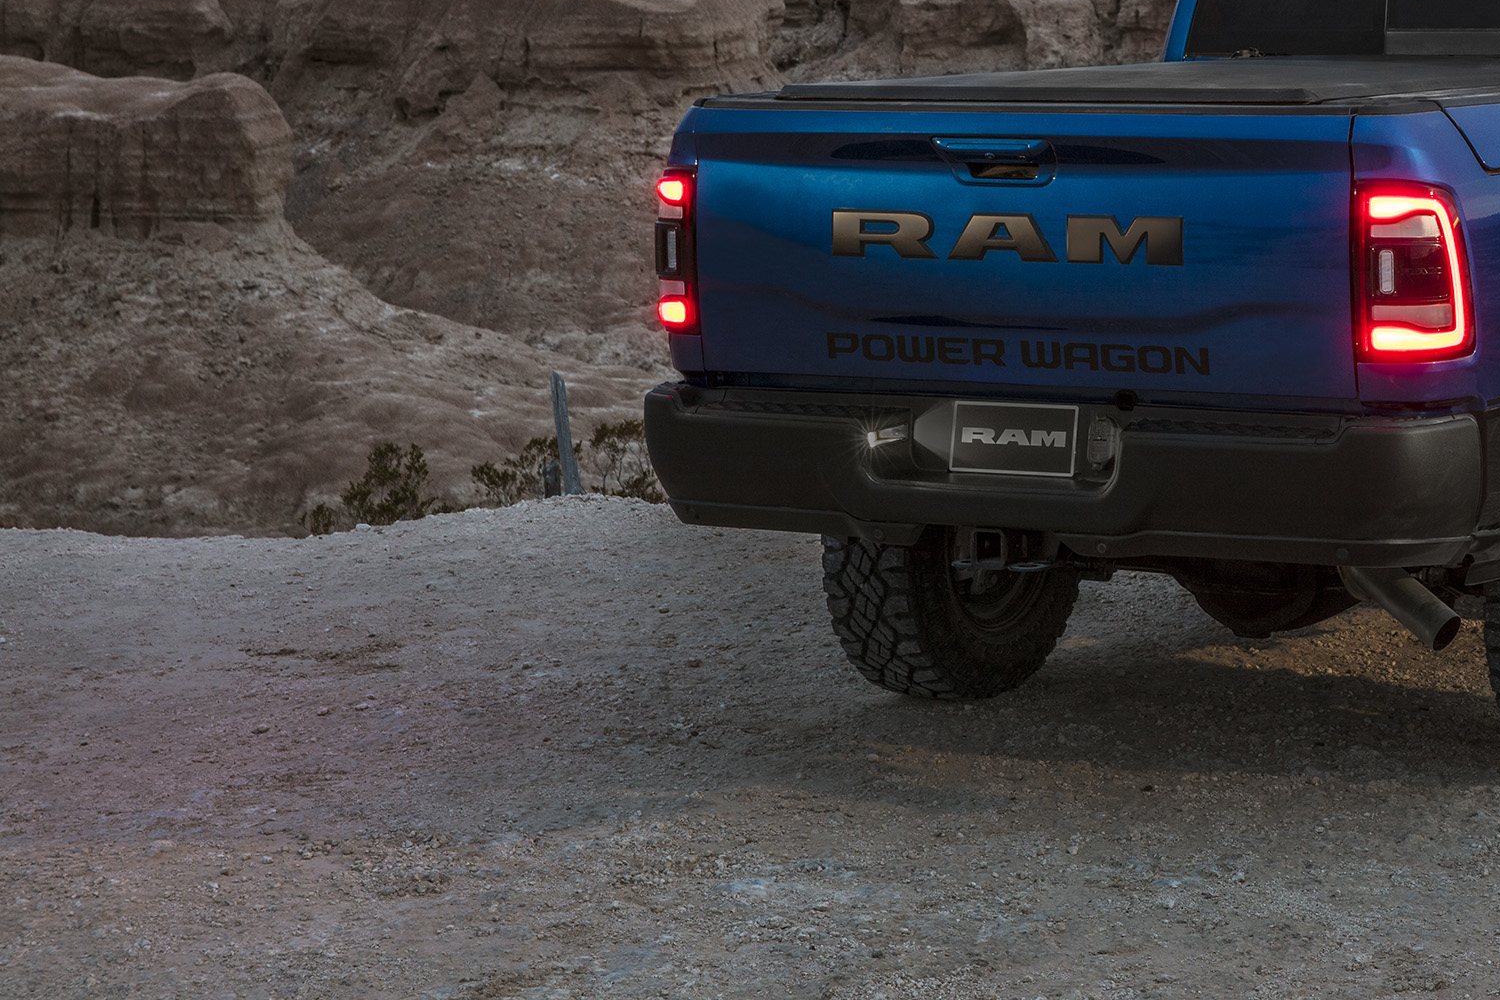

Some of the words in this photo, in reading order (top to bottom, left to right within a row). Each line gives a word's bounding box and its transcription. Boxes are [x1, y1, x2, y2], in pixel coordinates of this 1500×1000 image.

[831, 208, 1185, 266] RAM
[826, 332, 1006, 367] POWER
[1020, 340, 1210, 376] WAGON
[961, 427, 1067, 448] RAM
